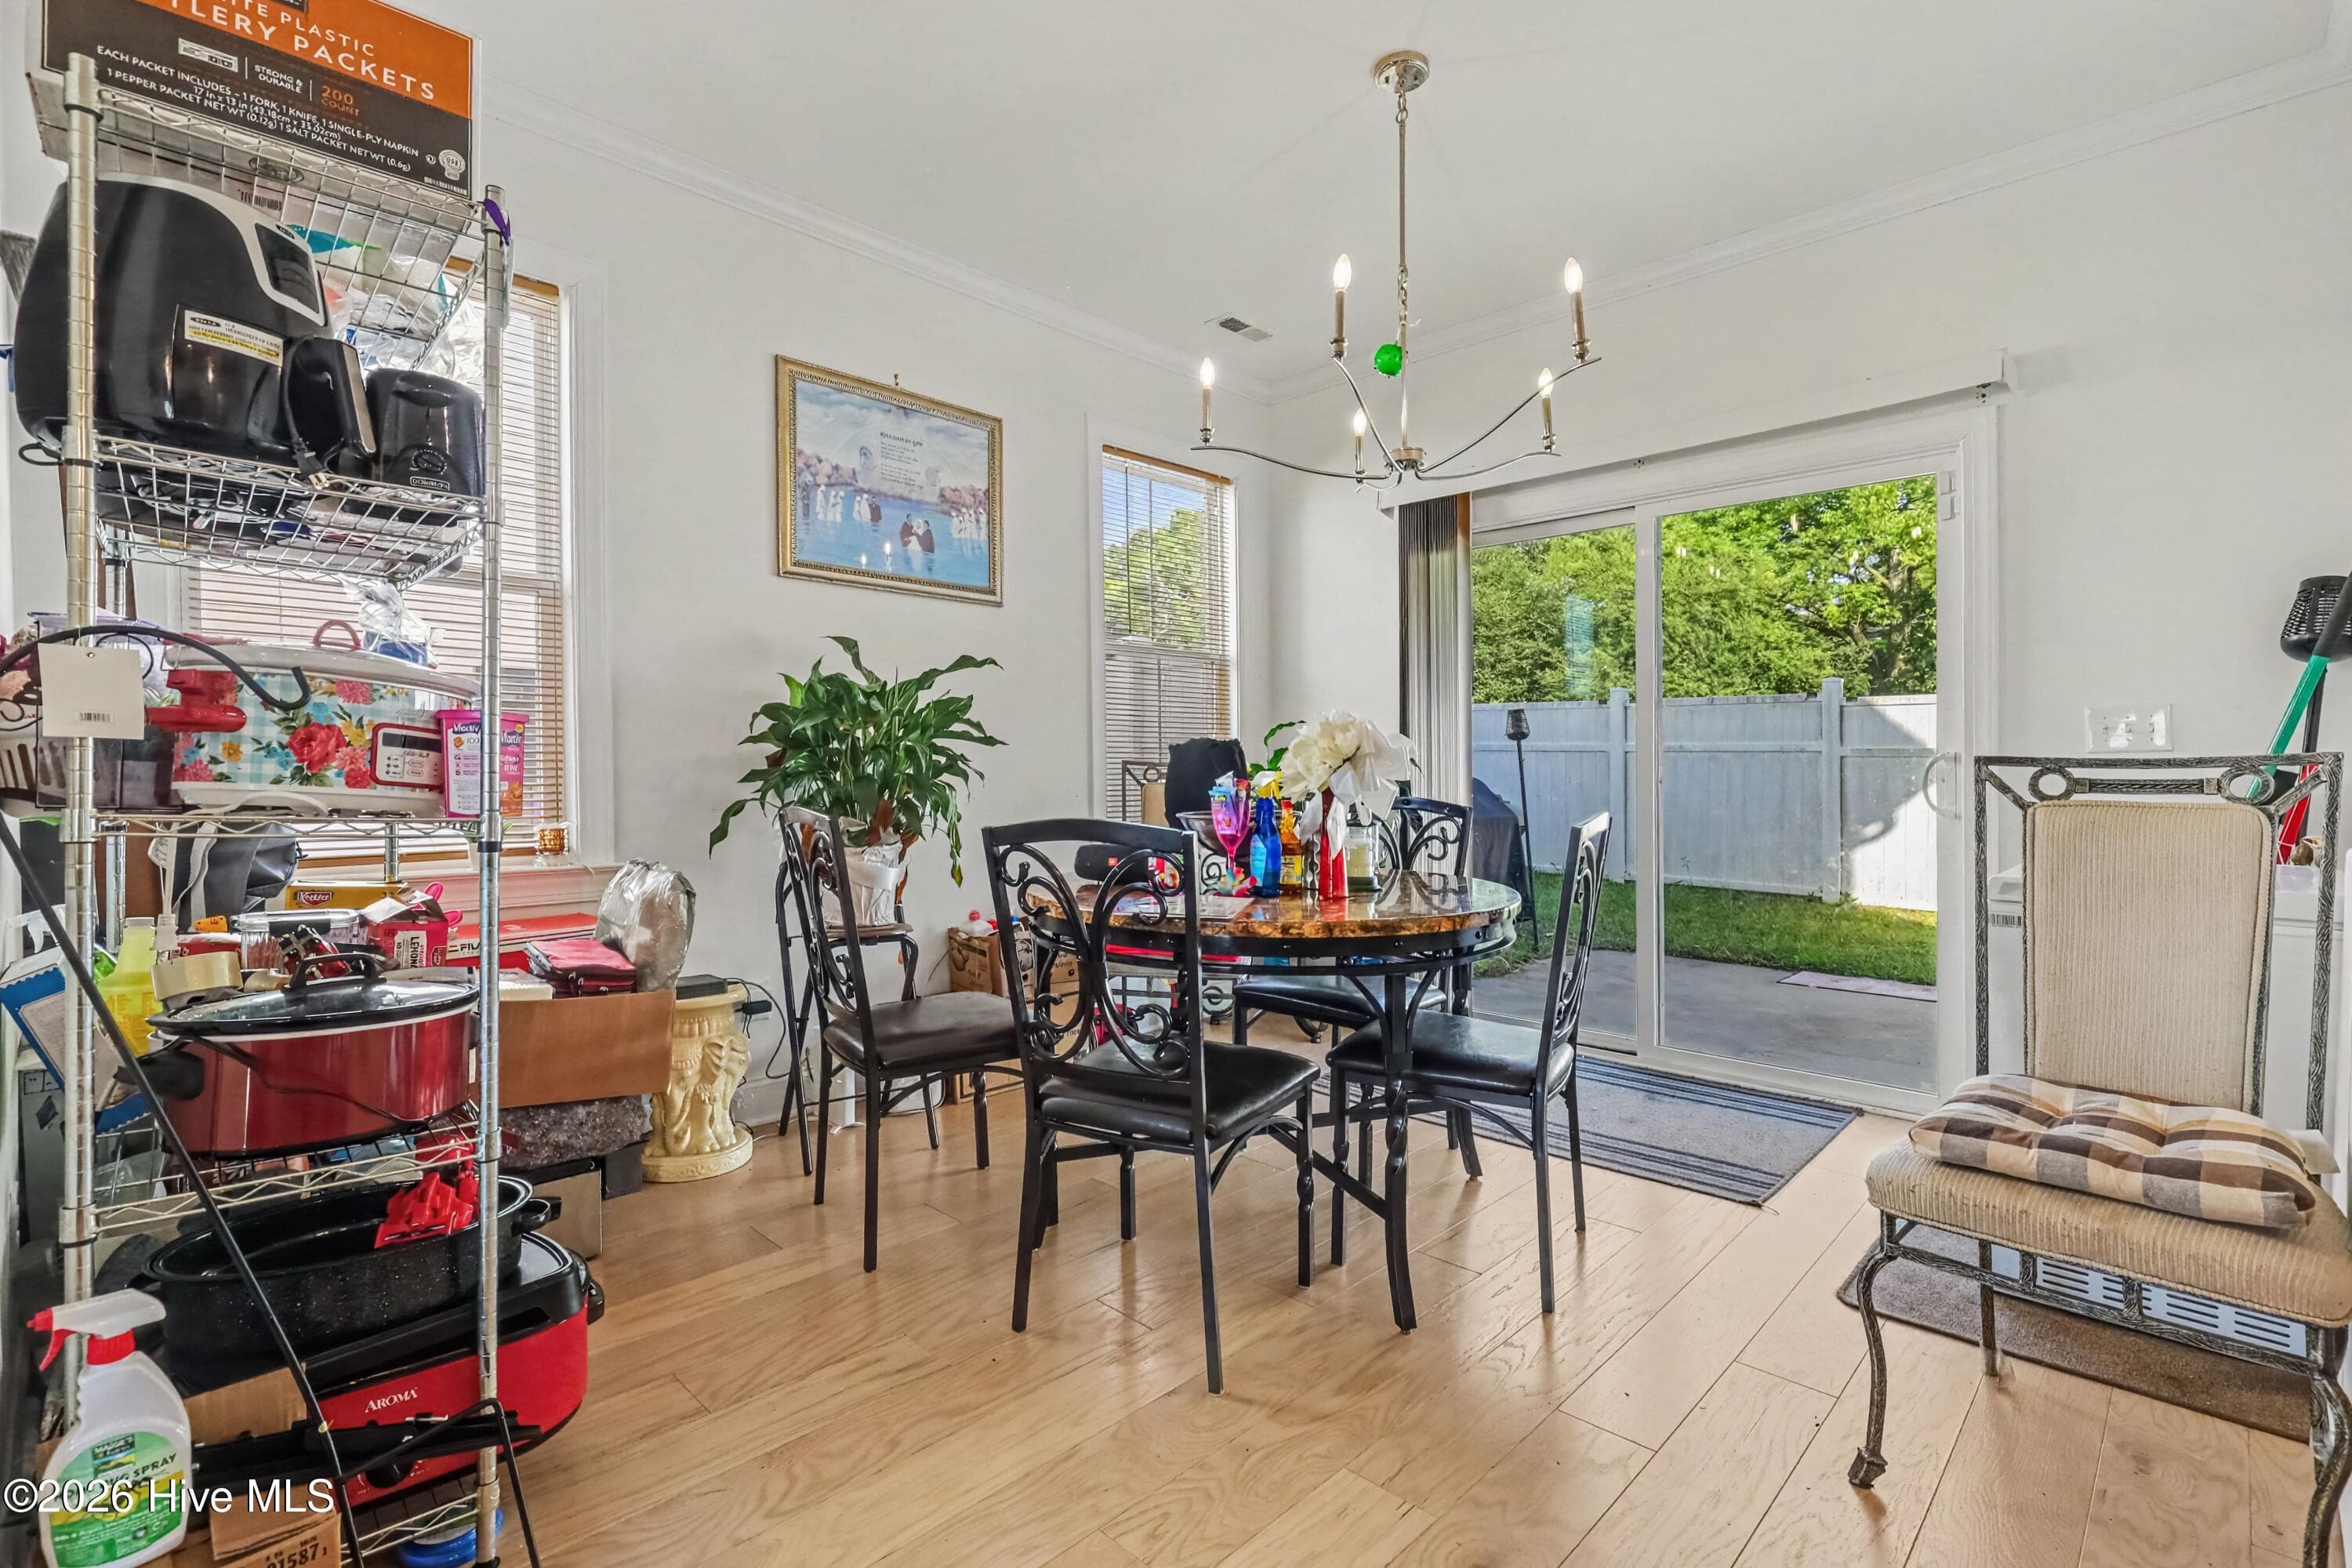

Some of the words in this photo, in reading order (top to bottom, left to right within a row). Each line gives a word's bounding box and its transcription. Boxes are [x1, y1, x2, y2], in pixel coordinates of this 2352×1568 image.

[281, 12, 376, 56] PLASTIC
[255, 64, 294, 83] STRONG
[294, 34, 434, 100] PACKETS
[193, 85, 205, 95] 17
[225, 96, 237, 106] 13
[258, 74, 302, 94] DURABLE
[321, 85, 354, 105] 200
[97, 45, 129, 63] EACH
[132, 58, 176, 78] PACKET
[177, 71, 232, 96] INCLUDES
[250, 94, 280, 112] FORK,
[328, 121, 383, 145] SINGLE-PLY
[383, 138, 419, 157] NAPKIN
[321, 97, 360, 117] COUNT
[115, 71, 158, 91] PEPPER
[159, 84, 202, 104] PACKET
[204, 99, 227, 112] NET
[227, 105, 247, 118] WT
[285, 125, 310, 139] SALT
[311, 132, 348, 151] PACKET
[350, 144, 370, 158] NET
[365, 1388, 418, 1414] AROMA
[132, 1452, 177, 1478] SPRAY
